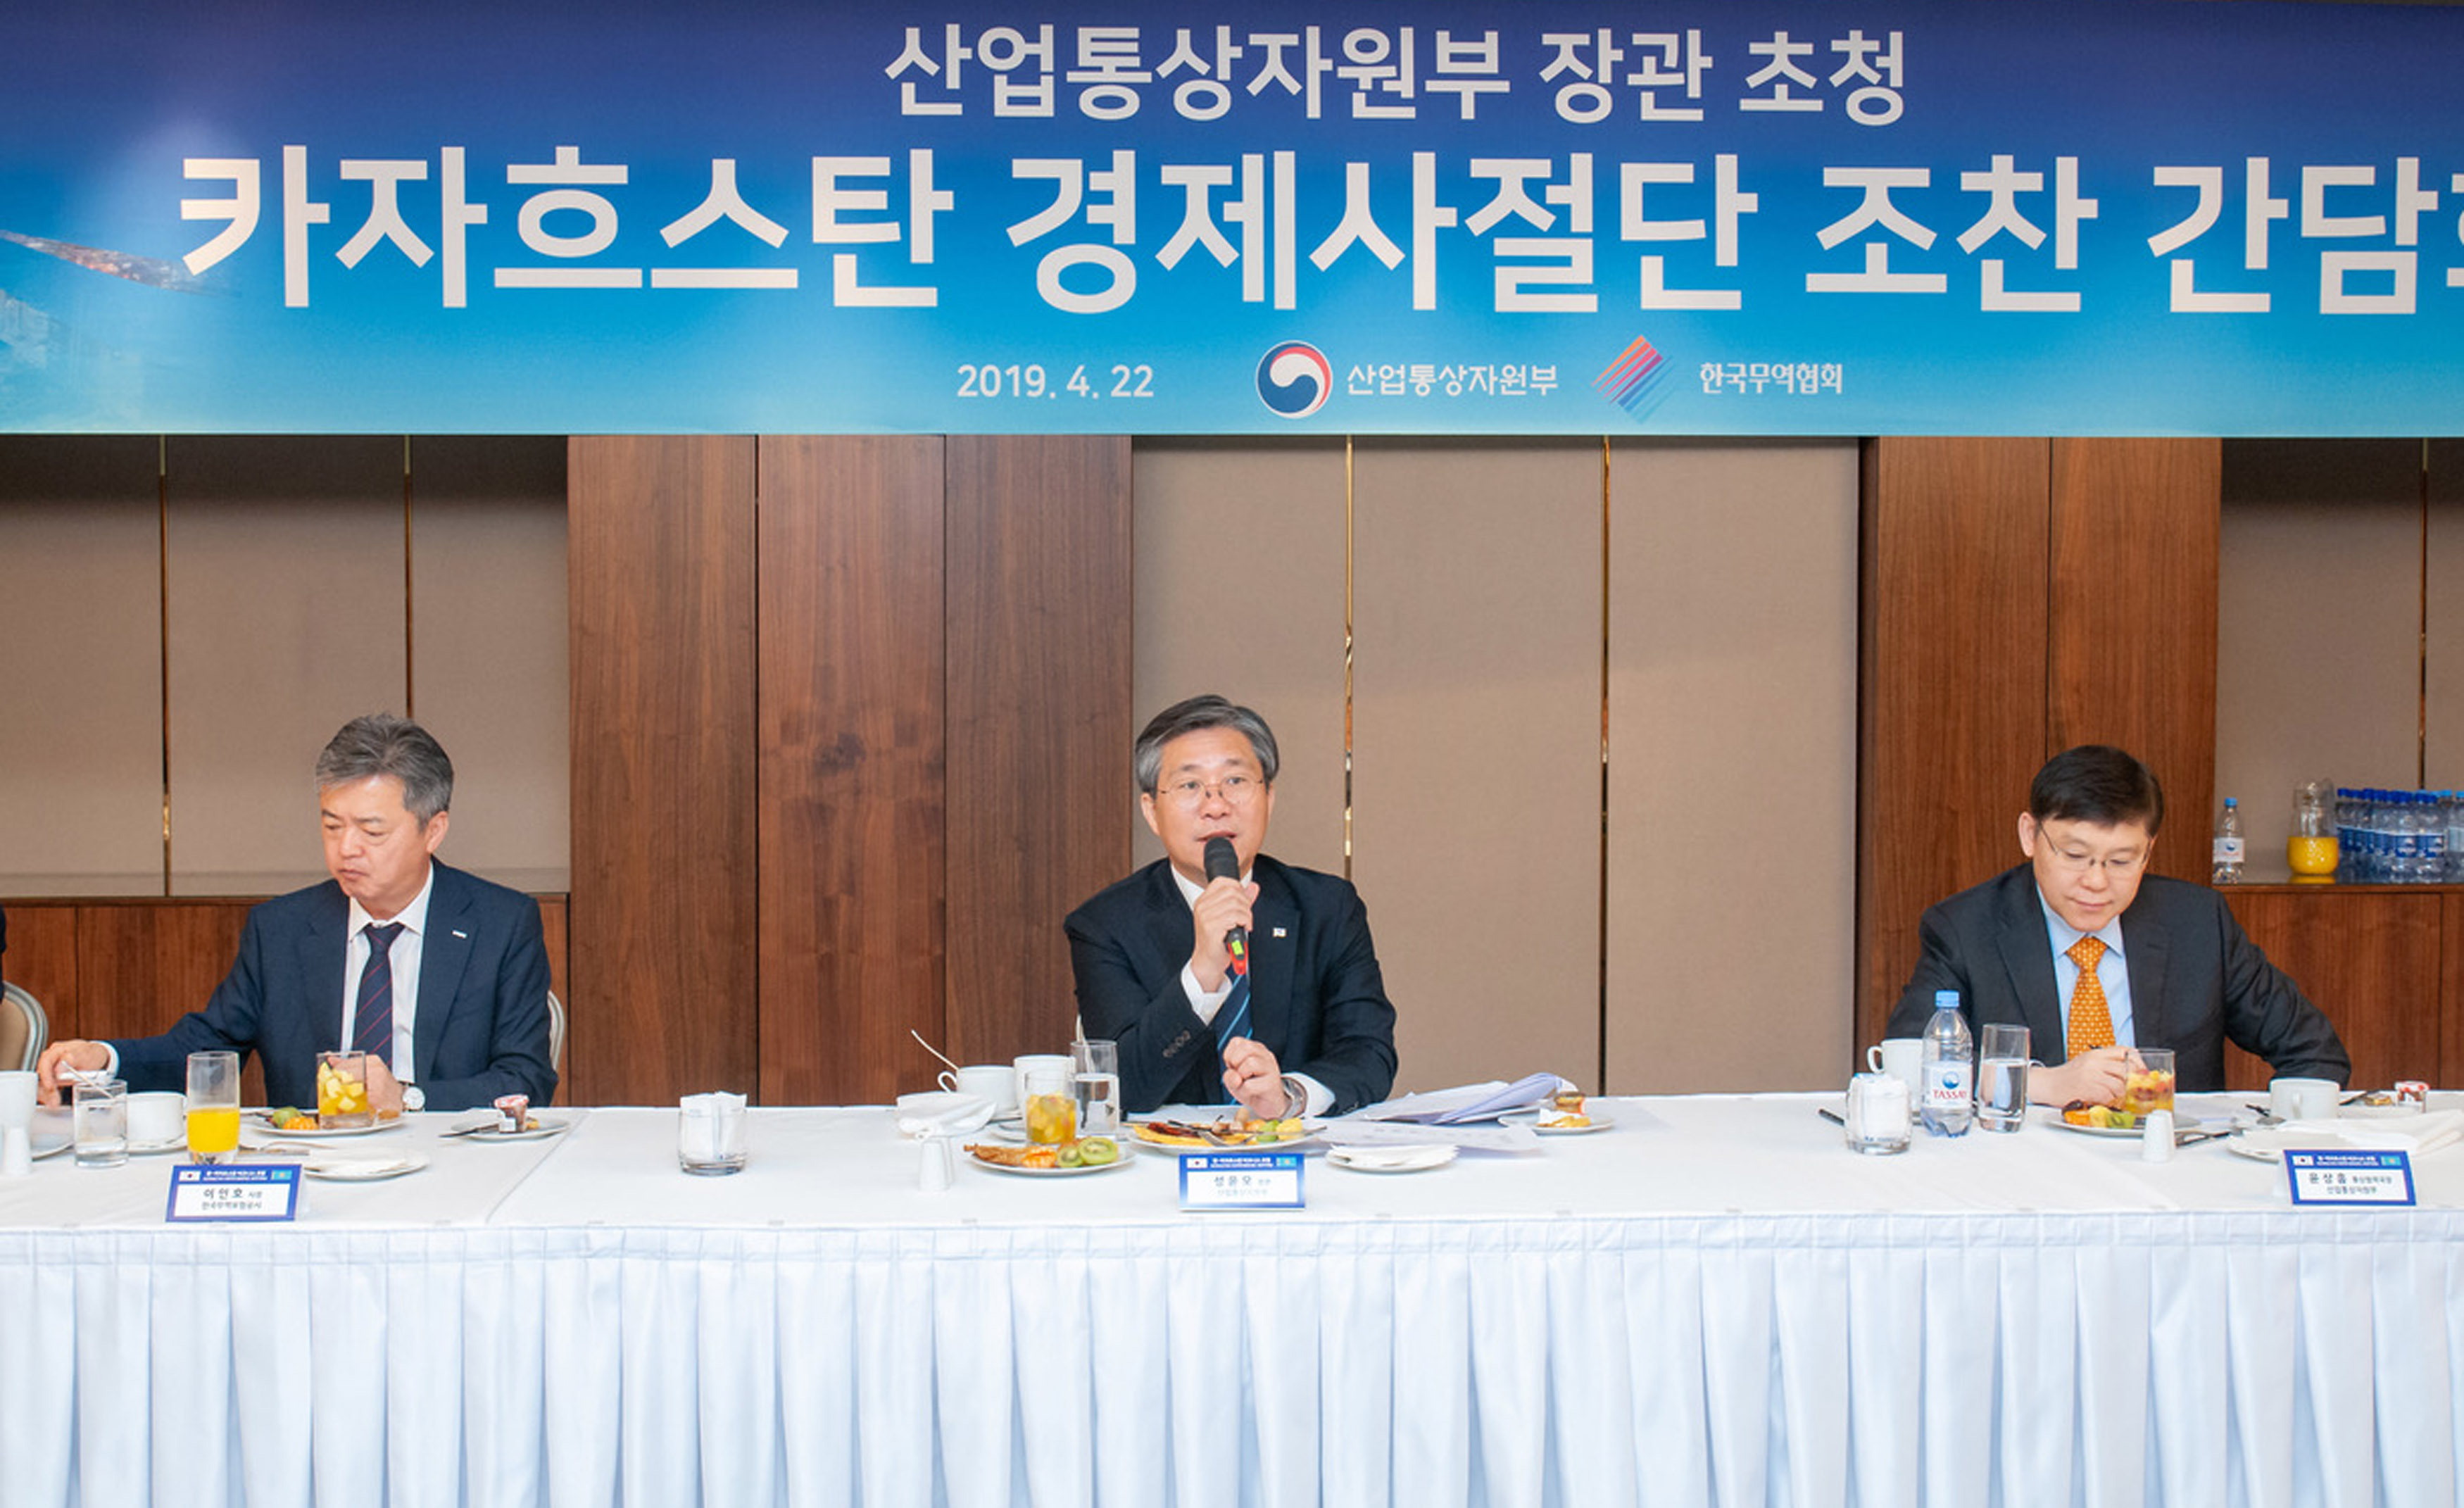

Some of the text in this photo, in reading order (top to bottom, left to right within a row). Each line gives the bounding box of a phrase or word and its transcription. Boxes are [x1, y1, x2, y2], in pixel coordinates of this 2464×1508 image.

[884, 24, 1904, 126] 산업통상자원부 장관 초청
[180, 145, 2464, 315] 카자흐스탄 경제사절단 조찬 간담
[957, 365, 1155, 399] 2019. 4. 22
[1347, 363, 1559, 398] 산업통상자원부
[1699, 363, 1843, 394] 한국무역협회
